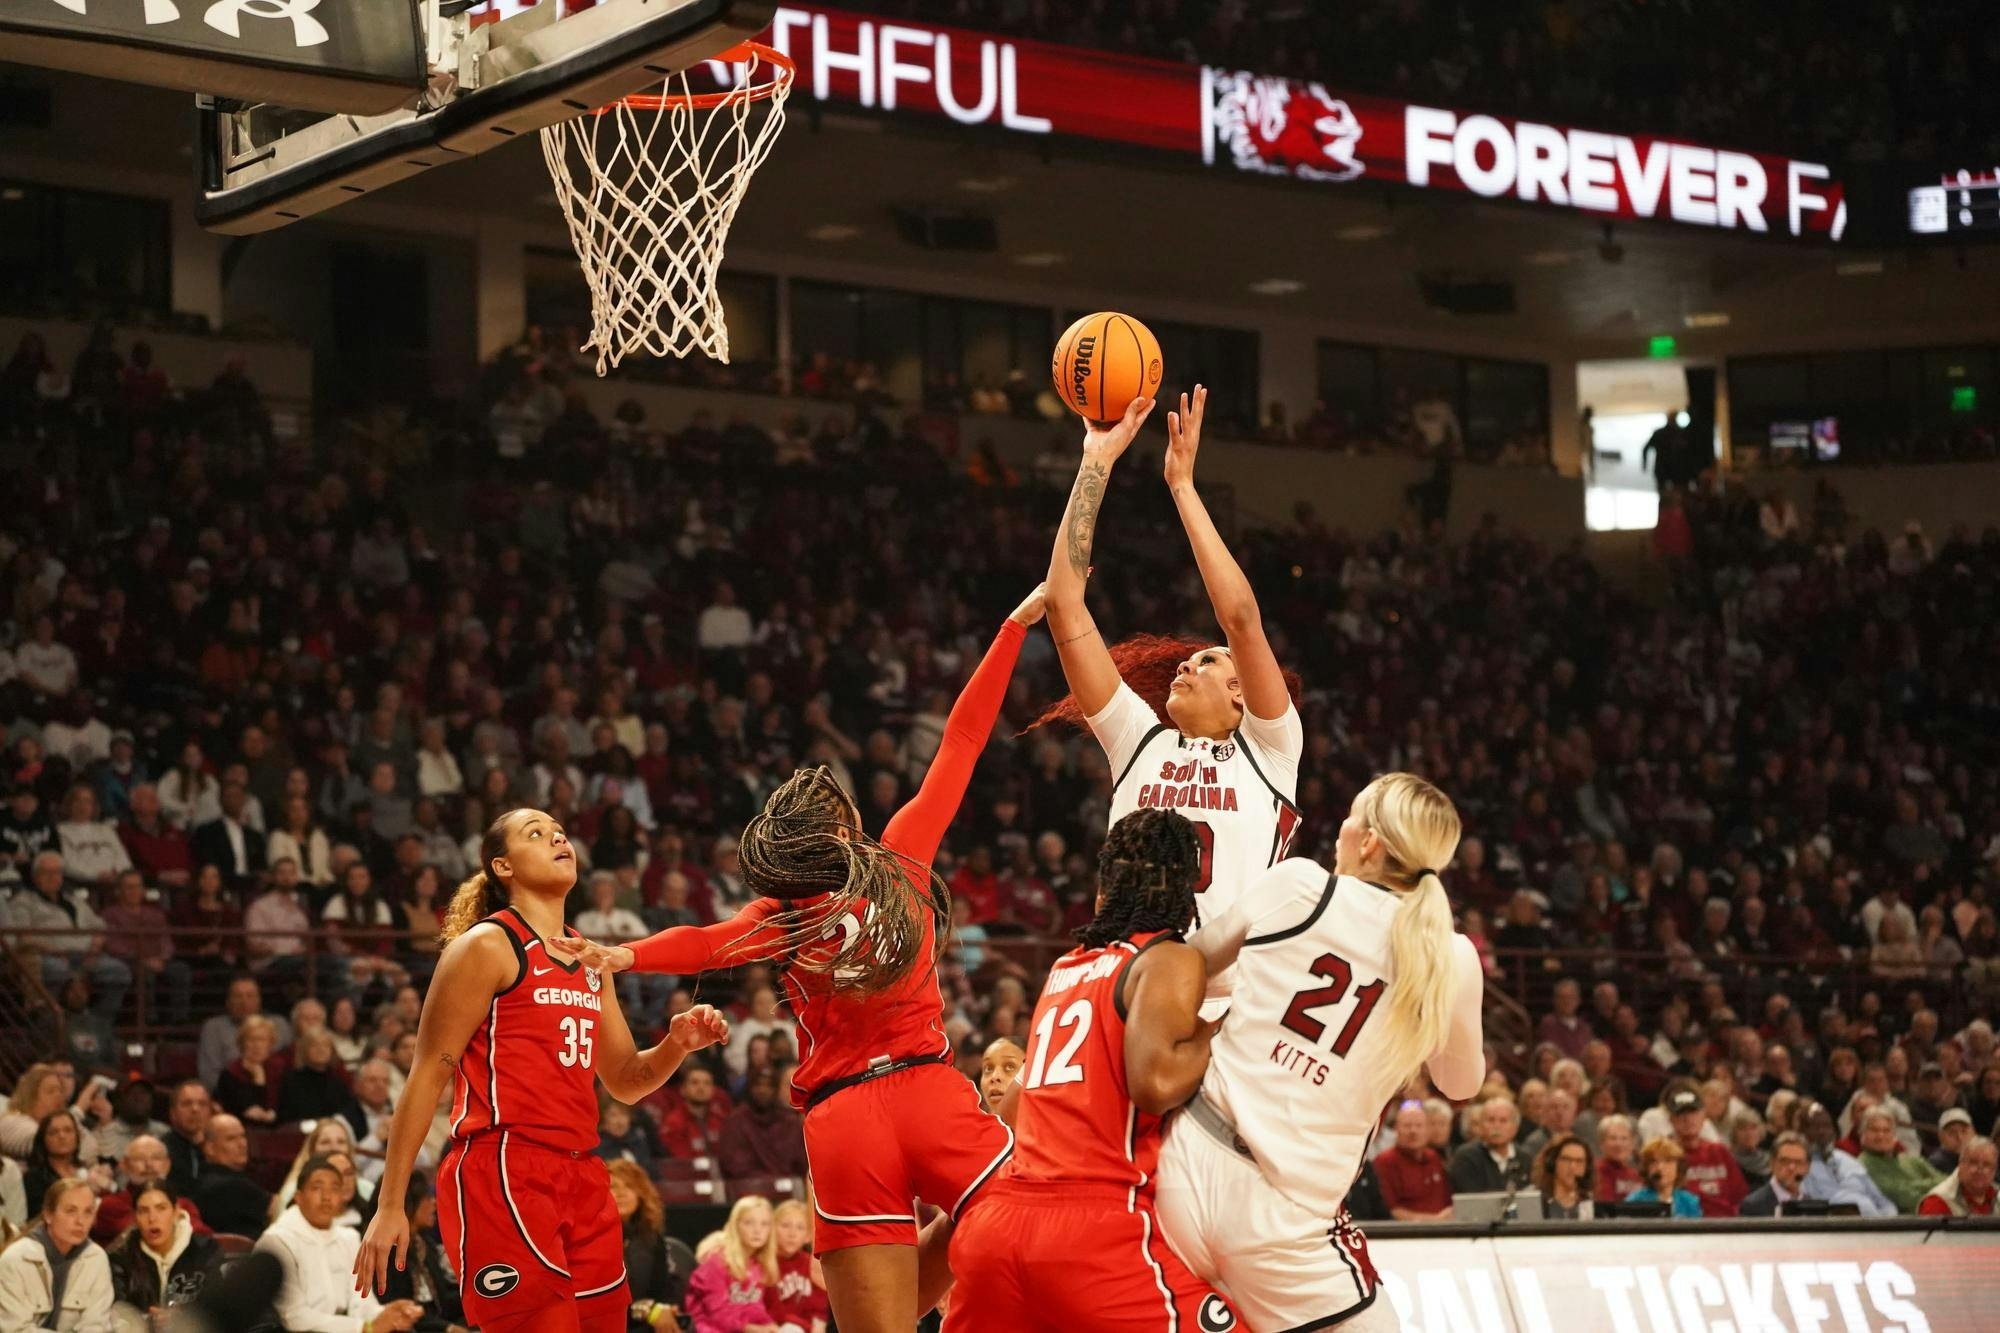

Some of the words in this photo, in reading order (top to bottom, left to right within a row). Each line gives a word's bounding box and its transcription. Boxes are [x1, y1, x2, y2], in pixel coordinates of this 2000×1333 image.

[1405, 104, 1768, 232] FOREVER
[1073, 336, 1097, 407] Wilson
[1138, 783, 1239, 812] CAROLINA
[1160, 758, 1218, 785] SOUH
[1280, 952, 1389, 1060] 21
[558, 1016, 594, 1069] 35
[1025, 998, 1093, 1090] 12
[1269, 1039, 1330, 1086] KITTS
[480, 1267, 519, 1294] G
[1585, 1260, 1934, 1333] TICKETS
[1203, 1296, 1236, 1328] G
